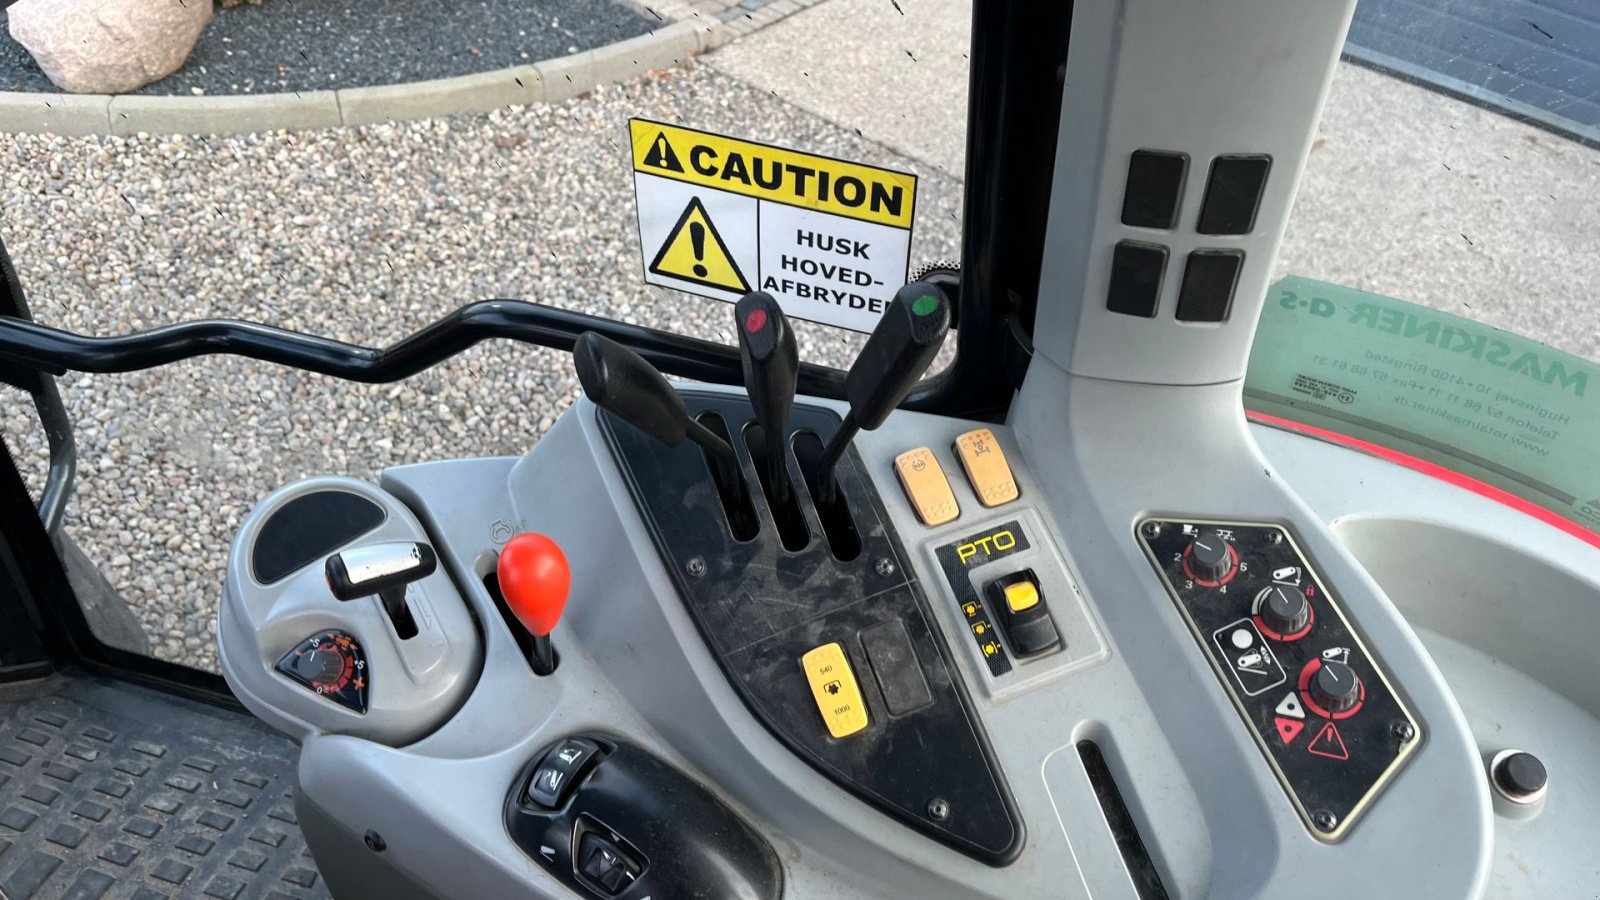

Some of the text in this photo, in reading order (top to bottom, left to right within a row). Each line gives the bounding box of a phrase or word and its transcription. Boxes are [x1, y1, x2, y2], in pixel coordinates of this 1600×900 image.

[690, 145, 904, 217] CAUTION
[796, 229, 870, 260] HUSK
[781, 254, 884, 288] HOVED-
[956, 530, 1016, 564] PTO
[1174, 552, 1182, 561] 2
[1240, 563, 1248, 572] 5
[1185, 580, 1193, 589] 3
[1219, 585, 1227, 594] 4
[834, 704, 851, 715] 1000
